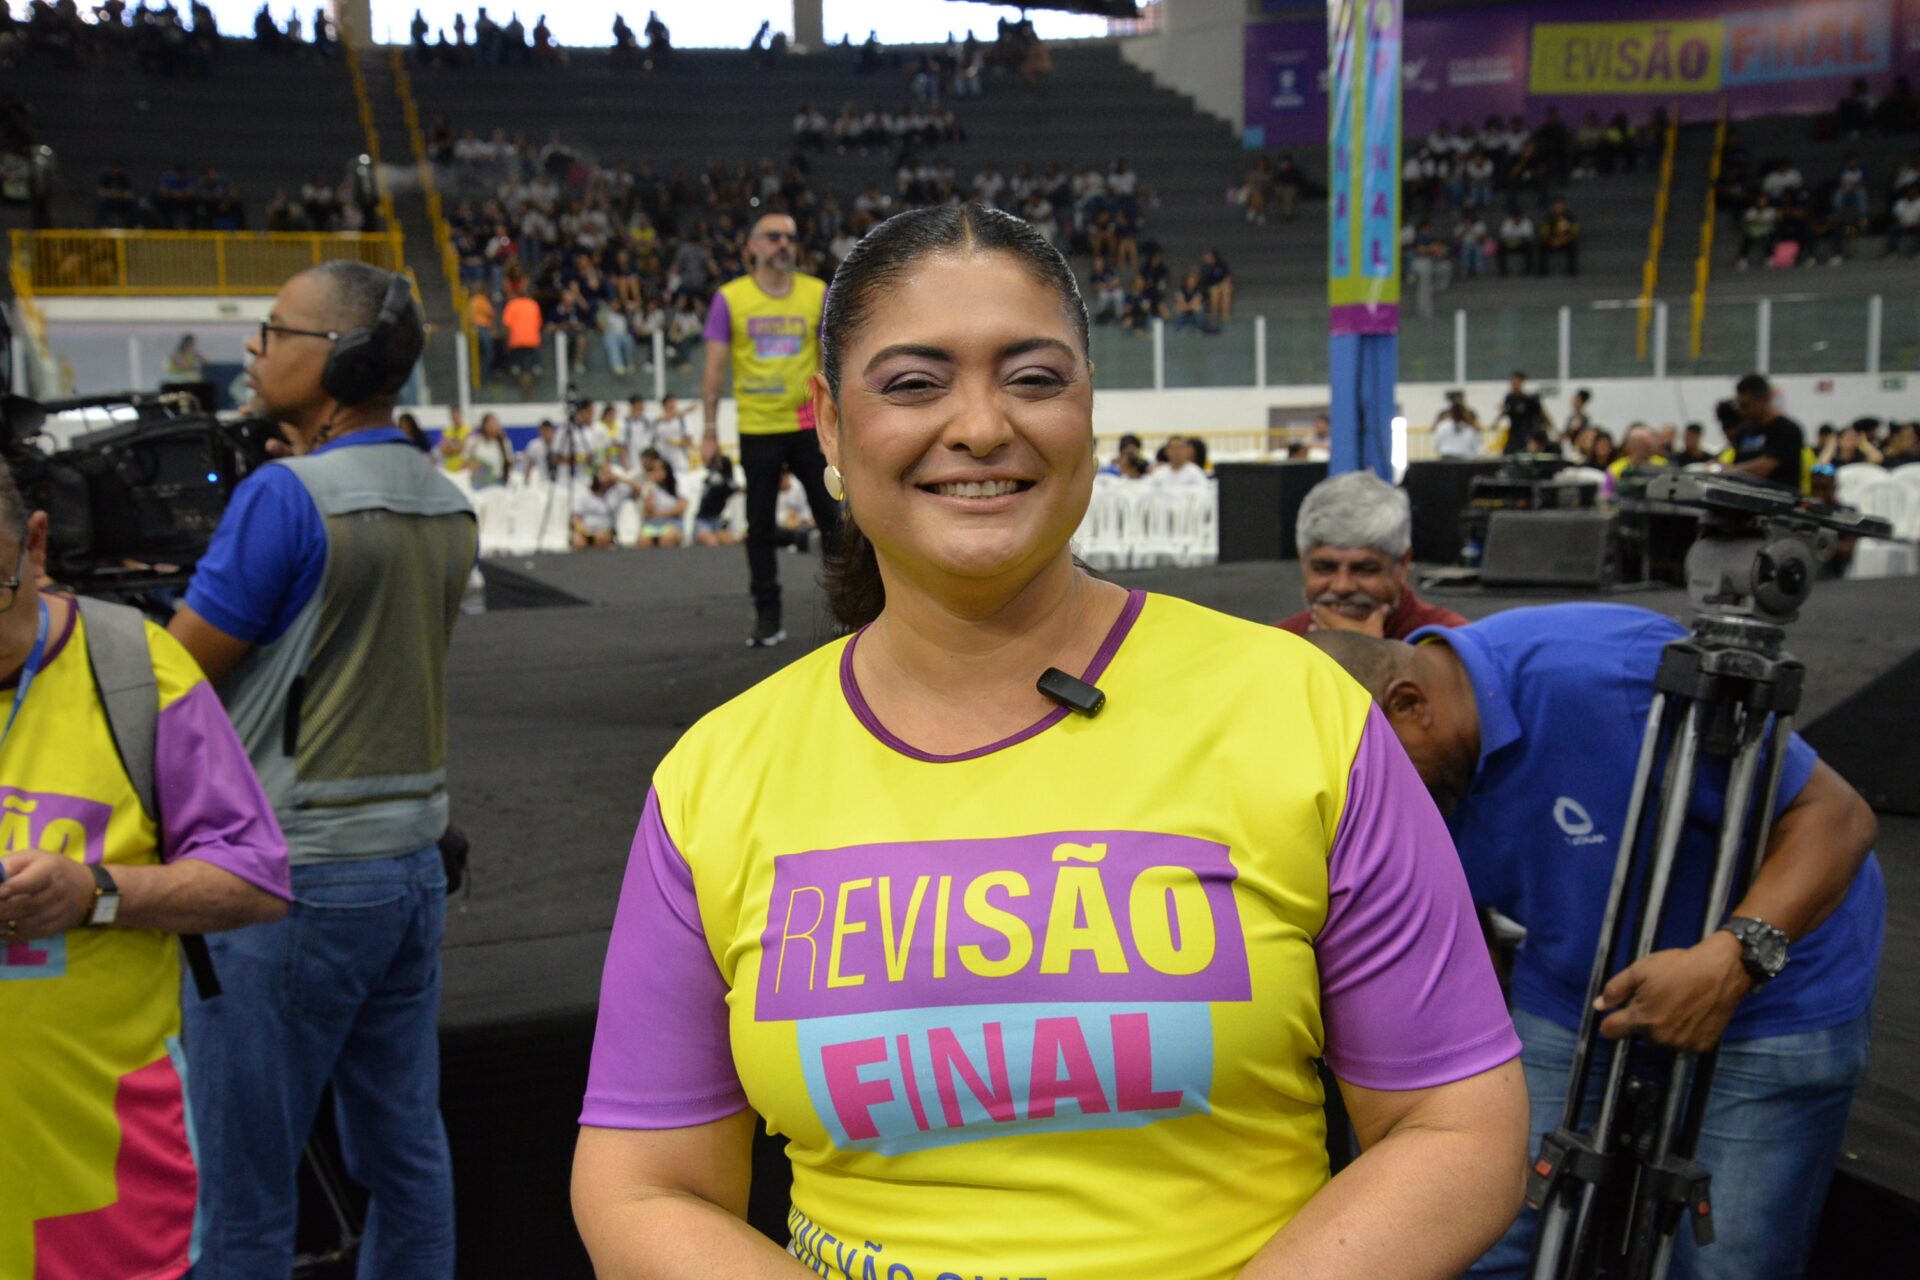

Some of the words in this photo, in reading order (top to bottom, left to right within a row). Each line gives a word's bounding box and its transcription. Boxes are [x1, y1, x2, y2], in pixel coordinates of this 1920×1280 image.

[1731, 16, 1878, 75] FINAL
[775, 842, 1217, 993] REVISÃO
[820, 1012, 1184, 1141] FINAL
